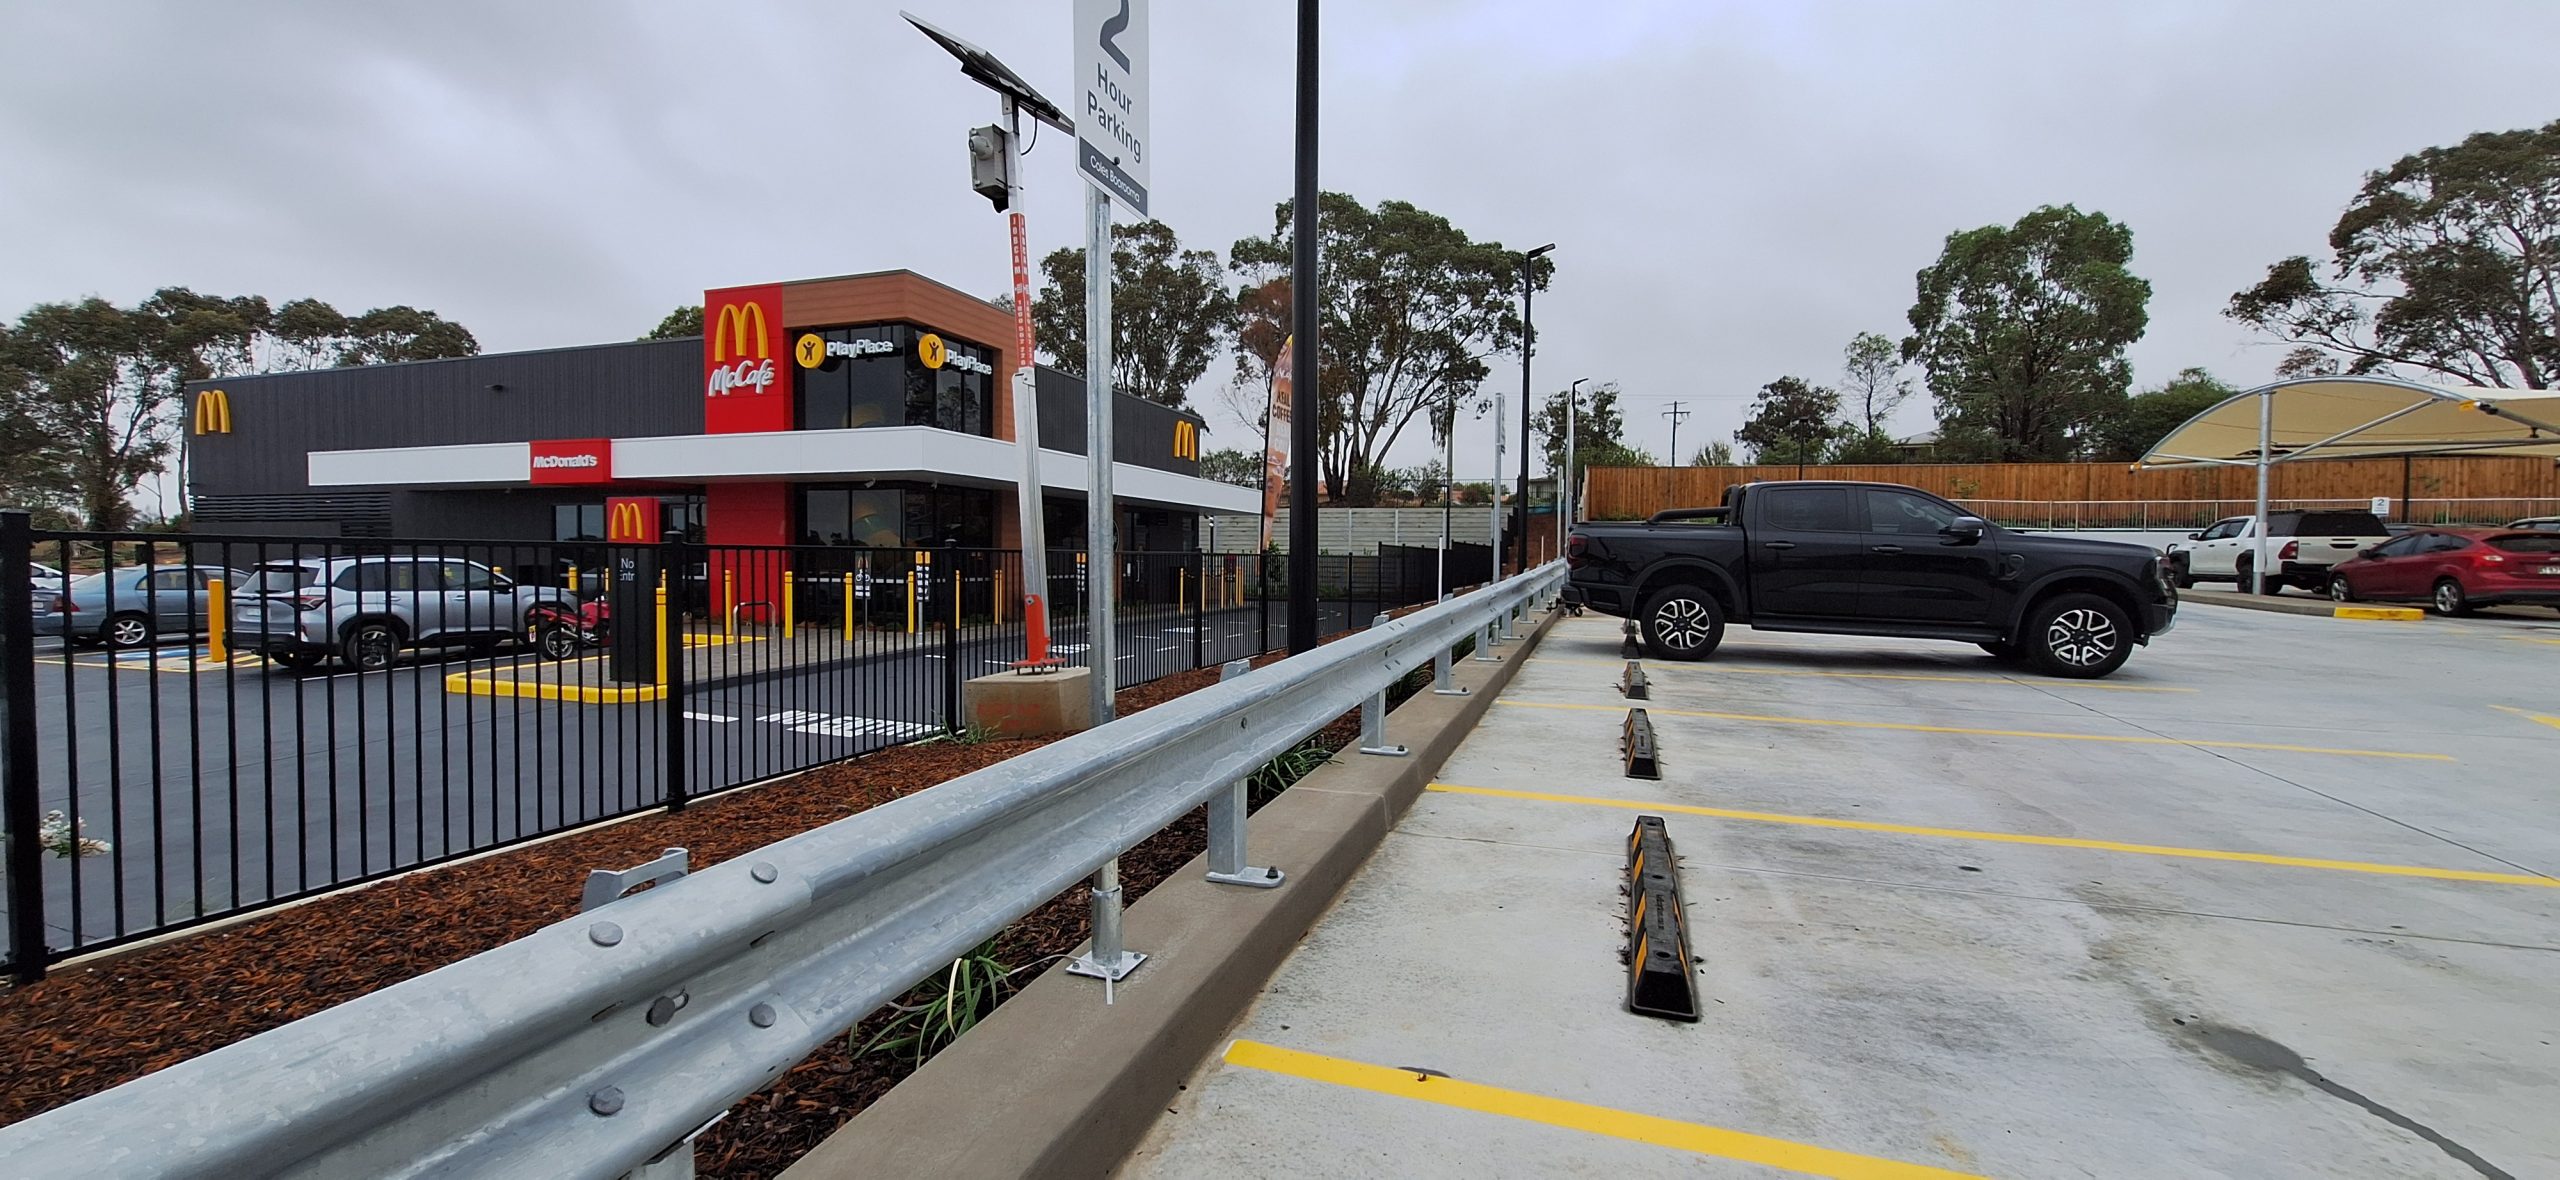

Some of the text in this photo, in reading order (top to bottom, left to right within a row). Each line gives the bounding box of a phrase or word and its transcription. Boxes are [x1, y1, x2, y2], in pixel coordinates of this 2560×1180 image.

[1097, 61, 1132, 115] Hour
[1087, 88, 1141, 164] Parking
[1090, 154, 1110, 181] Coles
[1012, 216, 1022, 275] JOBCAM
[826, 339, 894, 358] PlayPlace
[944, 348, 992, 375] PlayPlace
[708, 358, 776, 398] McCafé
[1272, 404, 1292, 424] COFFE
[532, 454, 598, 469] McDonald's
[620, 557, 635, 569] No
